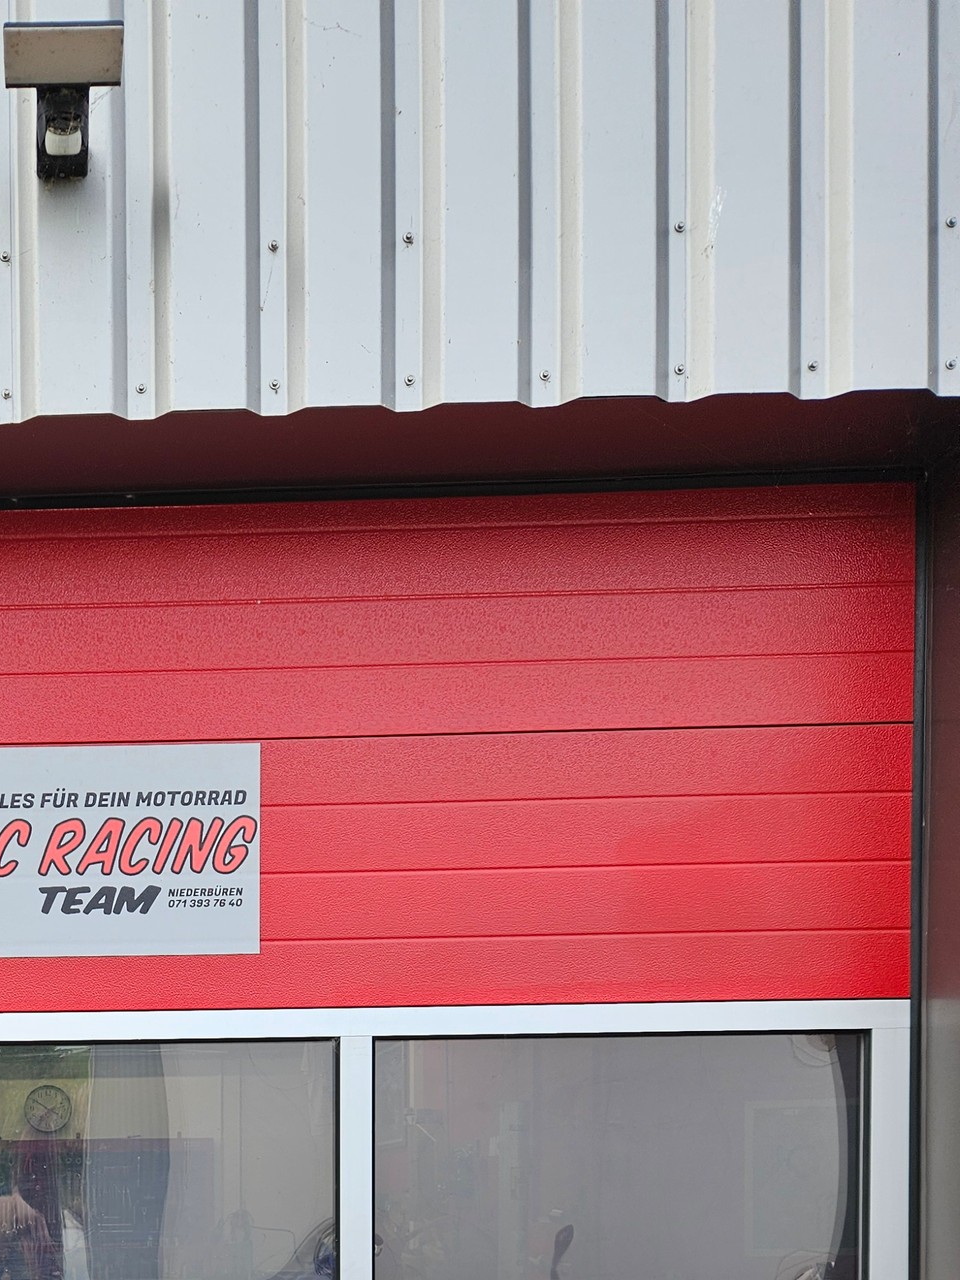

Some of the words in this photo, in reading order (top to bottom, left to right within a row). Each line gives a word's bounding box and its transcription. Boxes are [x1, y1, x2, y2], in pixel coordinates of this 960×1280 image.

[40, 788, 78, 808] FÜR
[84, 792, 130, 807] DEIN
[135, 790, 247, 807] MOTORRAD
[38, 815, 257, 876] RACING
[38, 885, 162, 915] TEAM
[168, 885, 243, 897] NIEDERBÜREN
[168, 900, 187, 908] 071
[189, 899, 211, 908] 393
[213, 899, 226, 908] 76
[228, 898, 243, 907] 40
